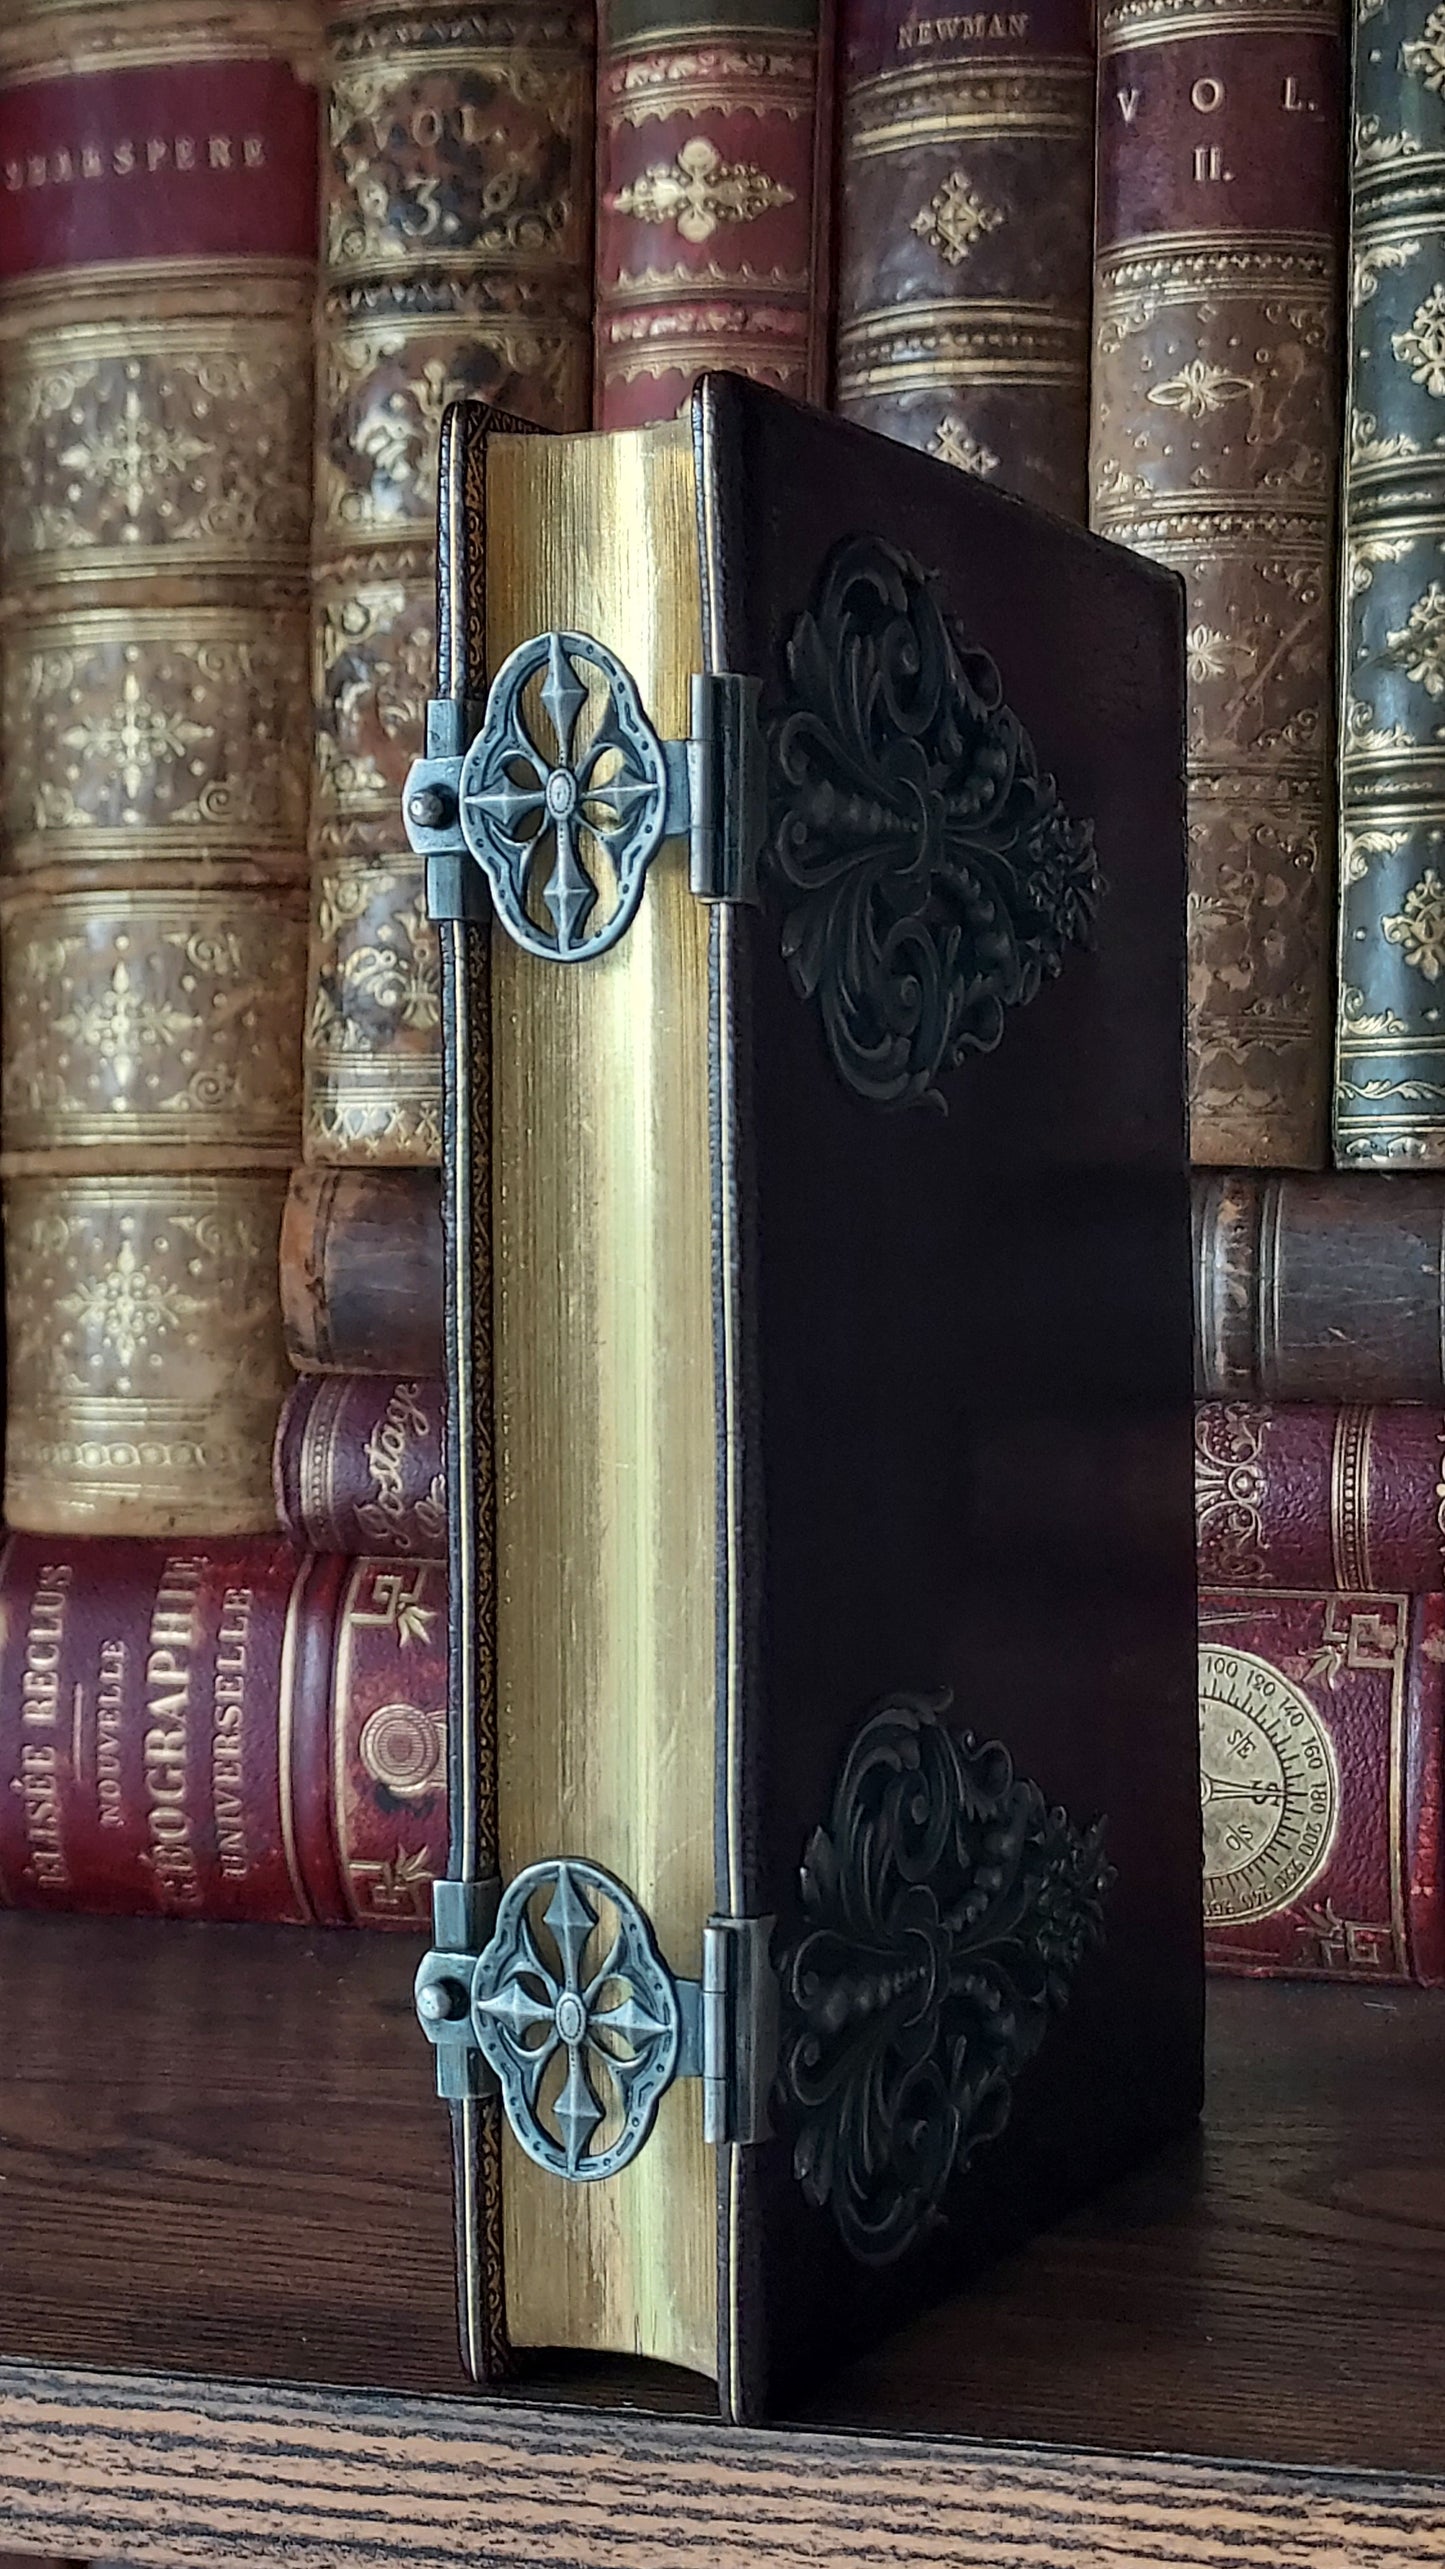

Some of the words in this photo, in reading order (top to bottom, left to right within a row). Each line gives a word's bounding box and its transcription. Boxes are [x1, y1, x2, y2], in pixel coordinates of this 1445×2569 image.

[896, 13, 1029, 50] NEWMAN
[21, 1564, 72, 1729] RECLUS
[1207, 1655, 1239, 1679] 100
[1246, 1669, 1276, 1697] 120
[136, 1555, 210, 1903] GÉOGRAPHIE
[1278, 1696, 1305, 1728] 140
[96, 1639, 127, 1829] NOUVELLE
[212, 1587, 253, 1882] UNIVERSELLE
[1300, 1736, 1323, 1770] 160
[1309, 1780, 1328, 1815] 180
[9, 1744, 69, 1889] ÉLISÉE
[1297, 1821, 1323, 1857] 200
[1273, 1858, 1306, 1891] 220
